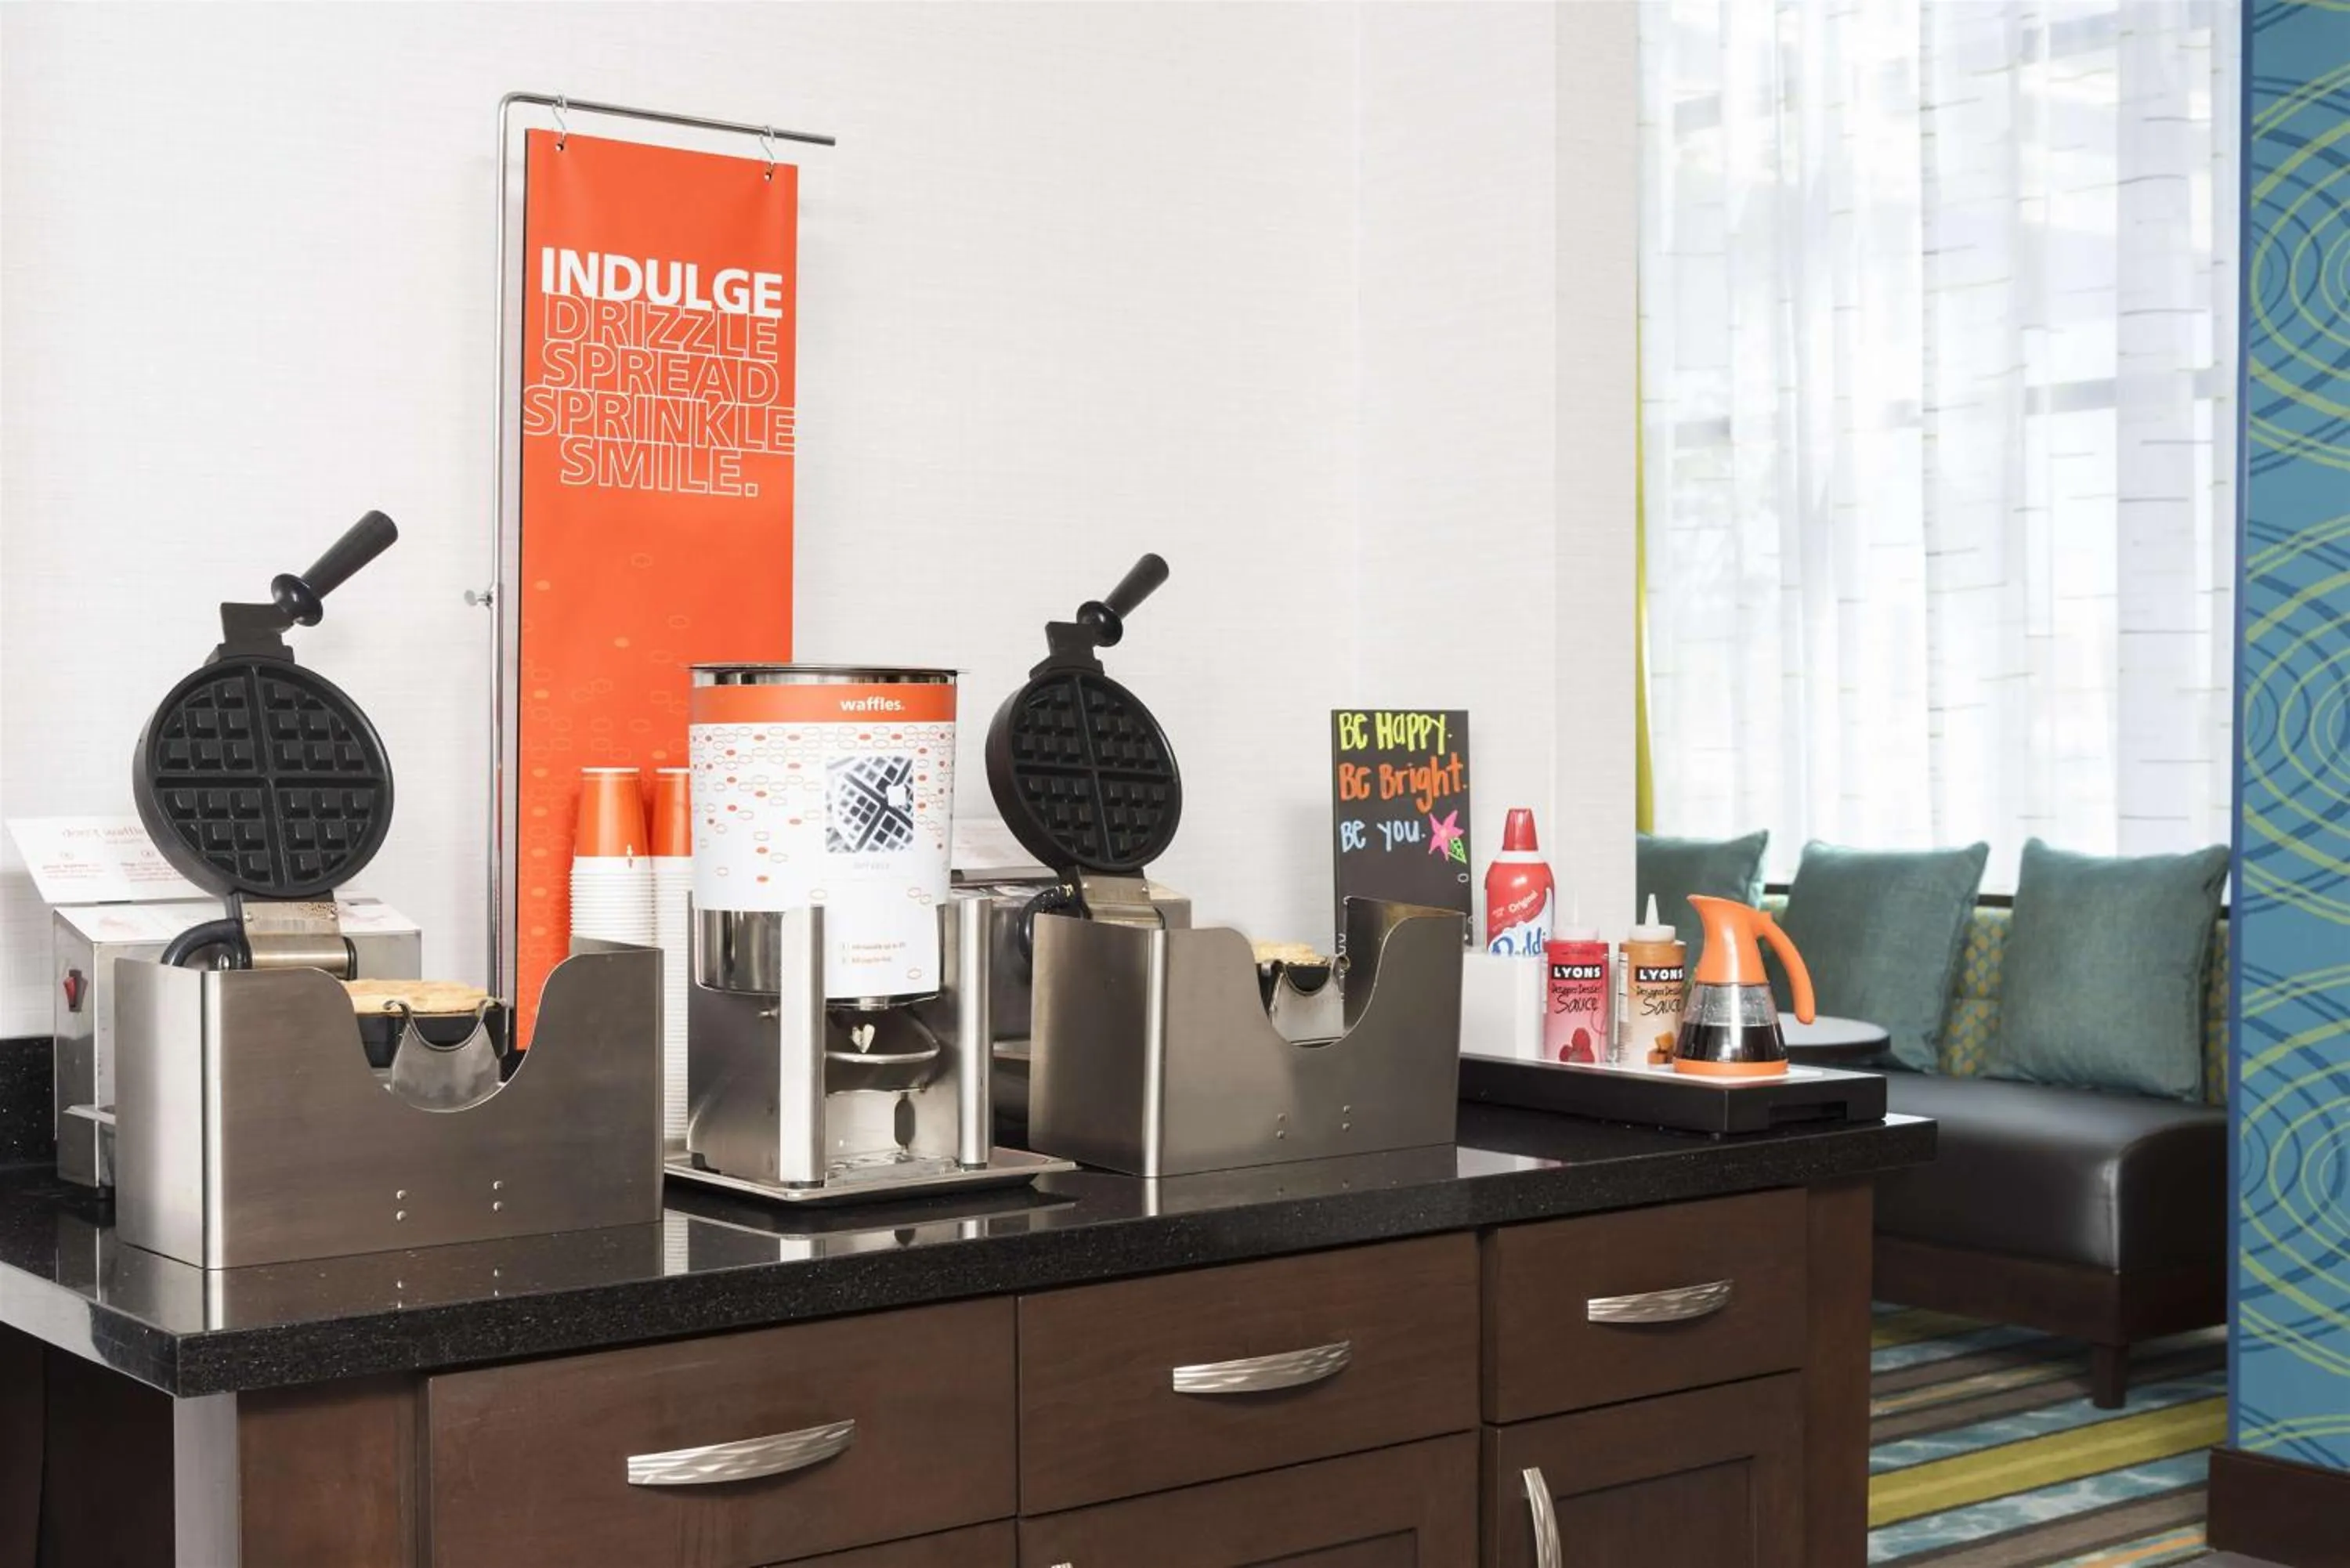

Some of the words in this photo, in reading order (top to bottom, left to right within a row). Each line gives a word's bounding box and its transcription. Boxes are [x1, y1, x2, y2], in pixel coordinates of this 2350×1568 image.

[540, 247, 783, 319] INDULGE
[545, 292, 779, 363] DRIZZLE
[542, 341, 780, 406] SPREAD
[523, 385, 795, 455] SPRINKLE
[560, 435, 759, 497] SMILE.
[840, 695, 906, 712] waffles.
[1508, 890, 1538, 913] Original
[1554, 966, 1600, 978] LYONS
[1640, 968, 1683, 981] LYONS
[1554, 994, 1599, 1014] Sauce
